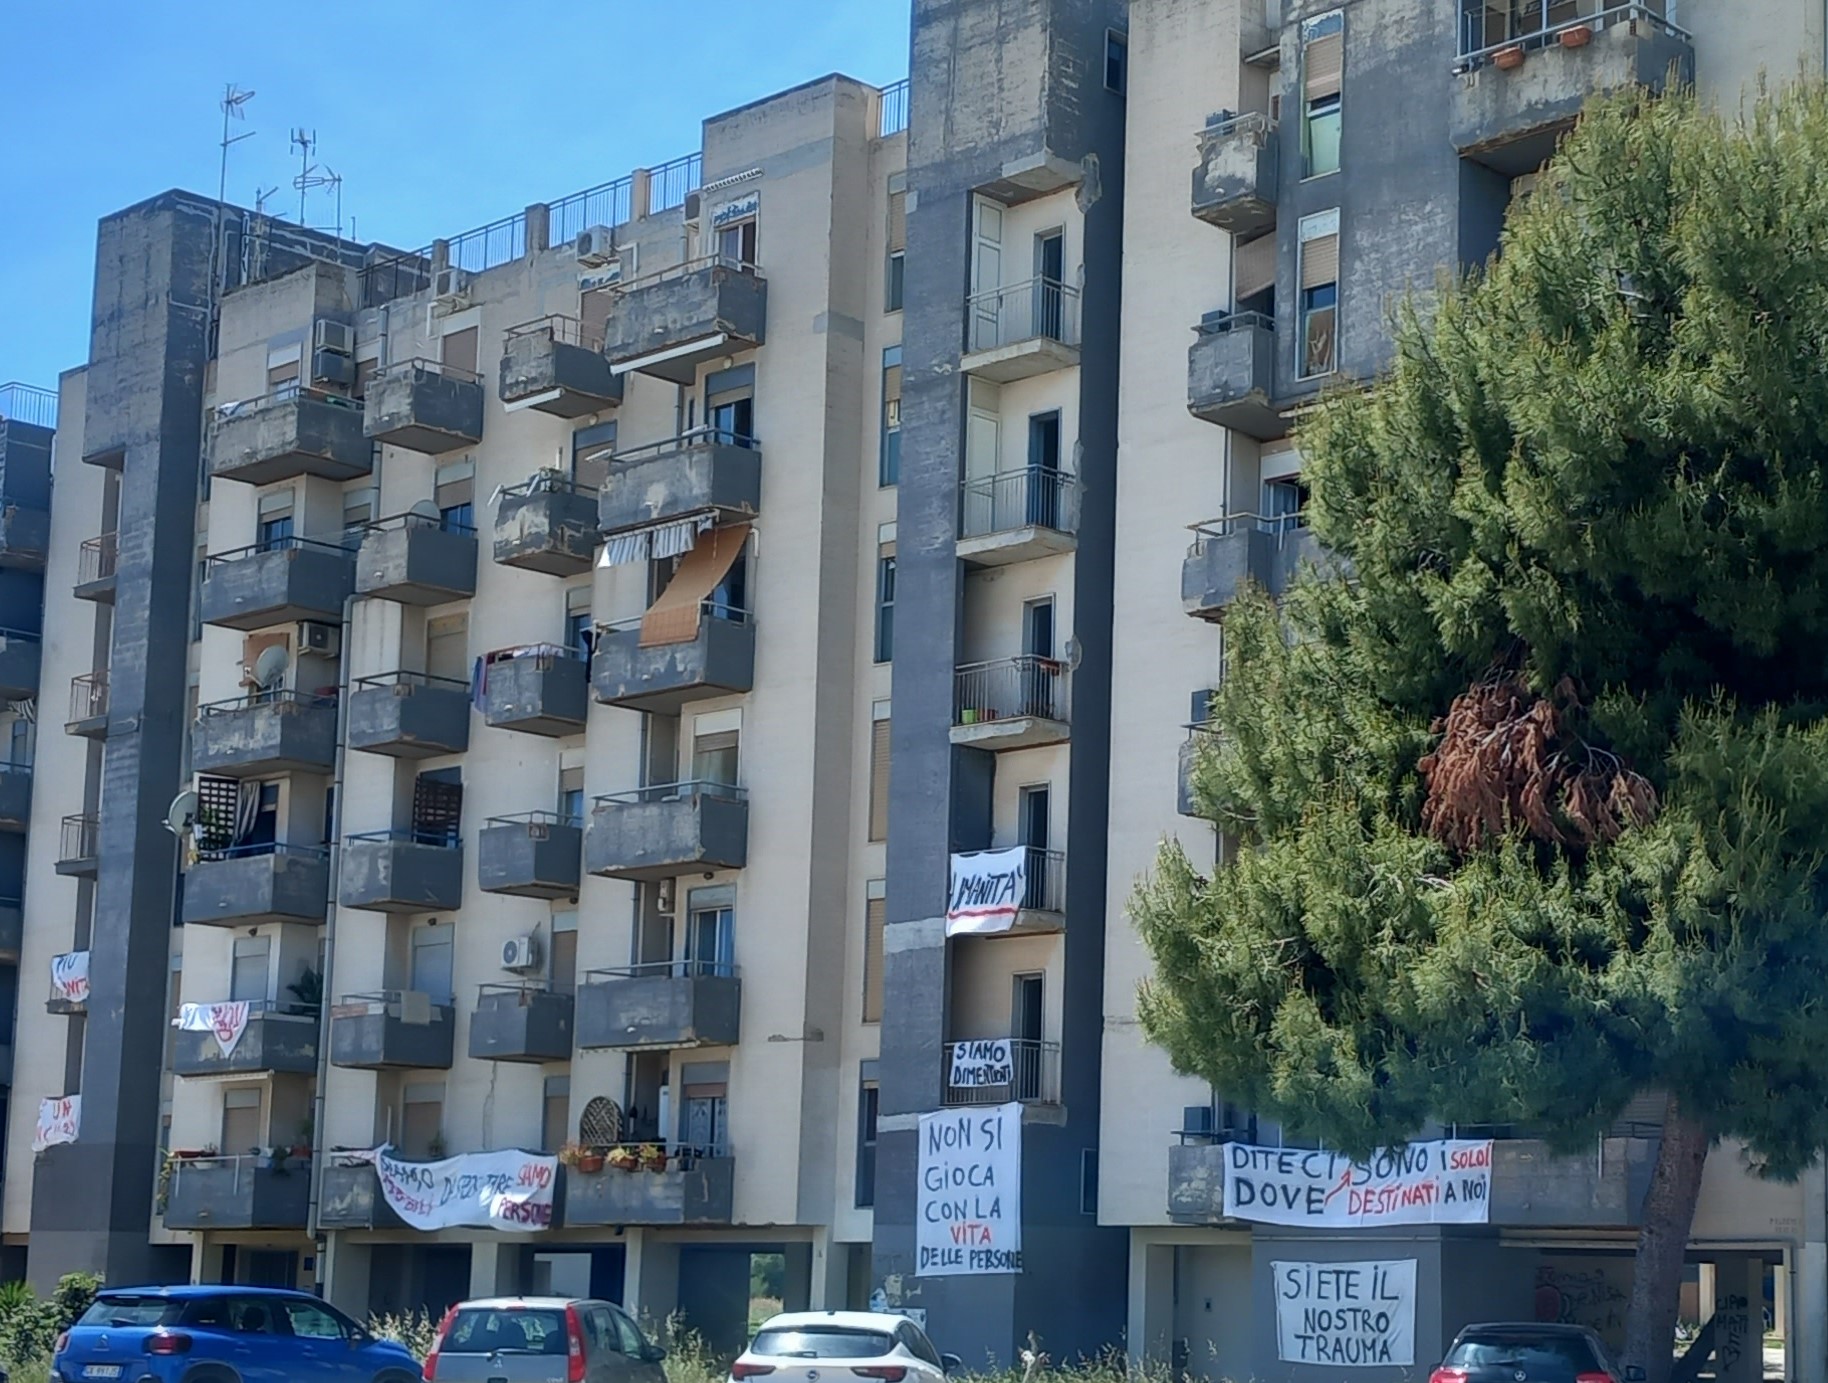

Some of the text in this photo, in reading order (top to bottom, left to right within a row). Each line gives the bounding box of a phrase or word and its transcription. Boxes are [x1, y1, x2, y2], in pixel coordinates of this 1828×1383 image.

[956, 1041, 1006, 1063] SIAMO
[928, 1108, 1003, 1156] NON SI
[924, 1160, 995, 1192] GIOCA
[1231, 1145, 1335, 1181] DITECI
[1350, 1143, 1429, 1186] SONO
[925, 1196, 1002, 1223] CON LA
[1234, 1176, 1326, 1216] DOVE
[1347, 1174, 1487, 1216] DESTINATI A NOI
[950, 1220, 992, 1246] VITA
[920, 1245, 1023, 1271] DELLE PERSONE
[1282, 1263, 1400, 1302] SIETE IL
[1303, 1307, 1390, 1334] NOSTRO
[1294, 1333, 1393, 1364] TRAUMA
